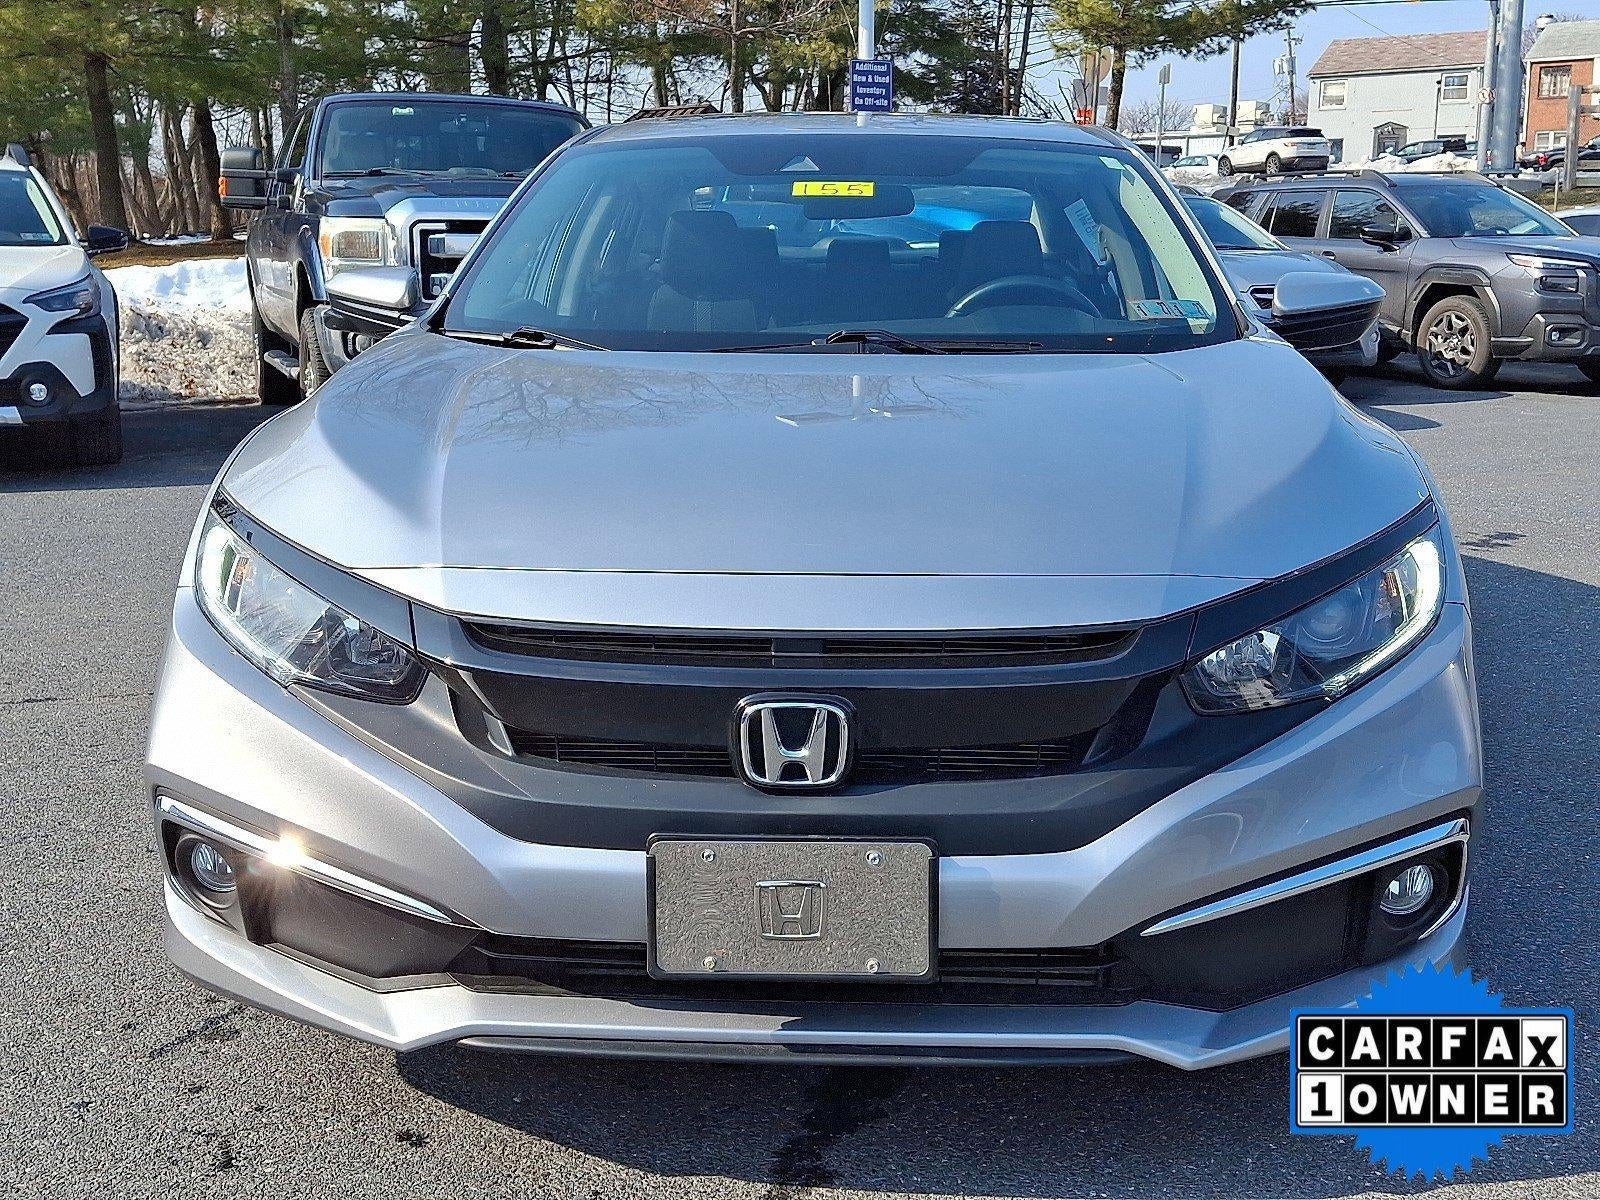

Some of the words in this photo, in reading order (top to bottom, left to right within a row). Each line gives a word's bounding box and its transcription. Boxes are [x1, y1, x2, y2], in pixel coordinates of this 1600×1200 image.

[856, 62, 888, 72] Additional
[853, 74, 866, 82] New
[868, 74, 872, 82] &
[874, 75, 890, 83] Used
[856, 86, 886, 96] Inventory
[864, 98, 888, 106] Off-site
[803, 183, 870, 195] 155
